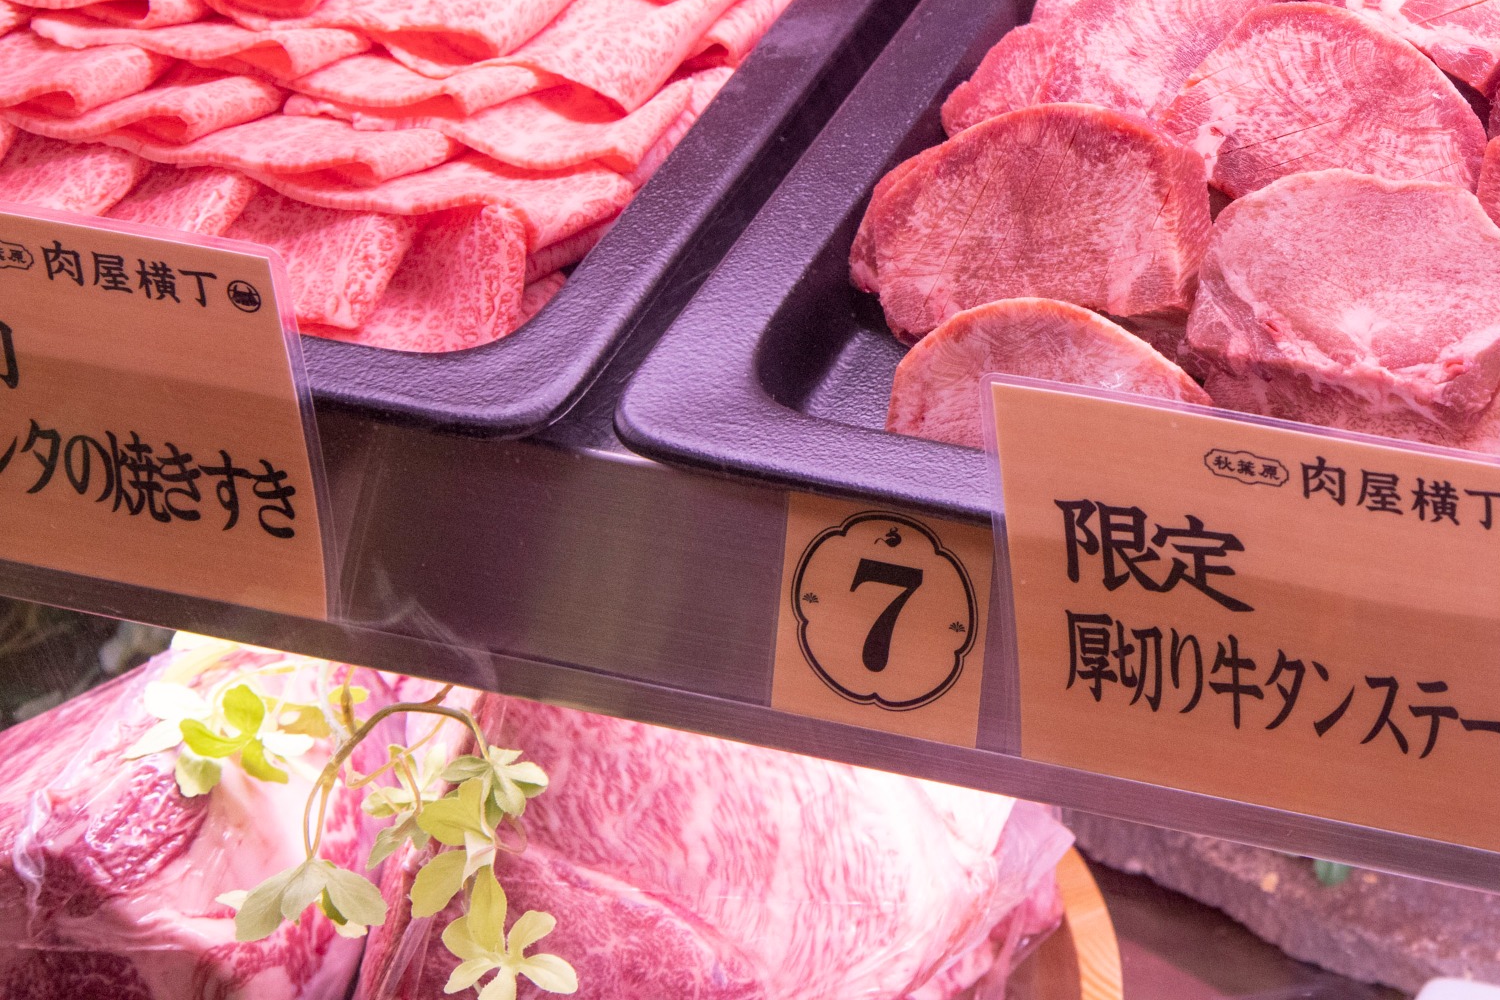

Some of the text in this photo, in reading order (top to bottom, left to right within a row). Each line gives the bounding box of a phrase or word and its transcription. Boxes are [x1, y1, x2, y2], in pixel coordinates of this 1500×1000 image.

[41, 240, 217, 307] 肉屋横丁
[1214, 455, 1281, 481] 秋葉原
[1054, 499, 1254, 612] 限定
[850, 558, 923, 672] 7
